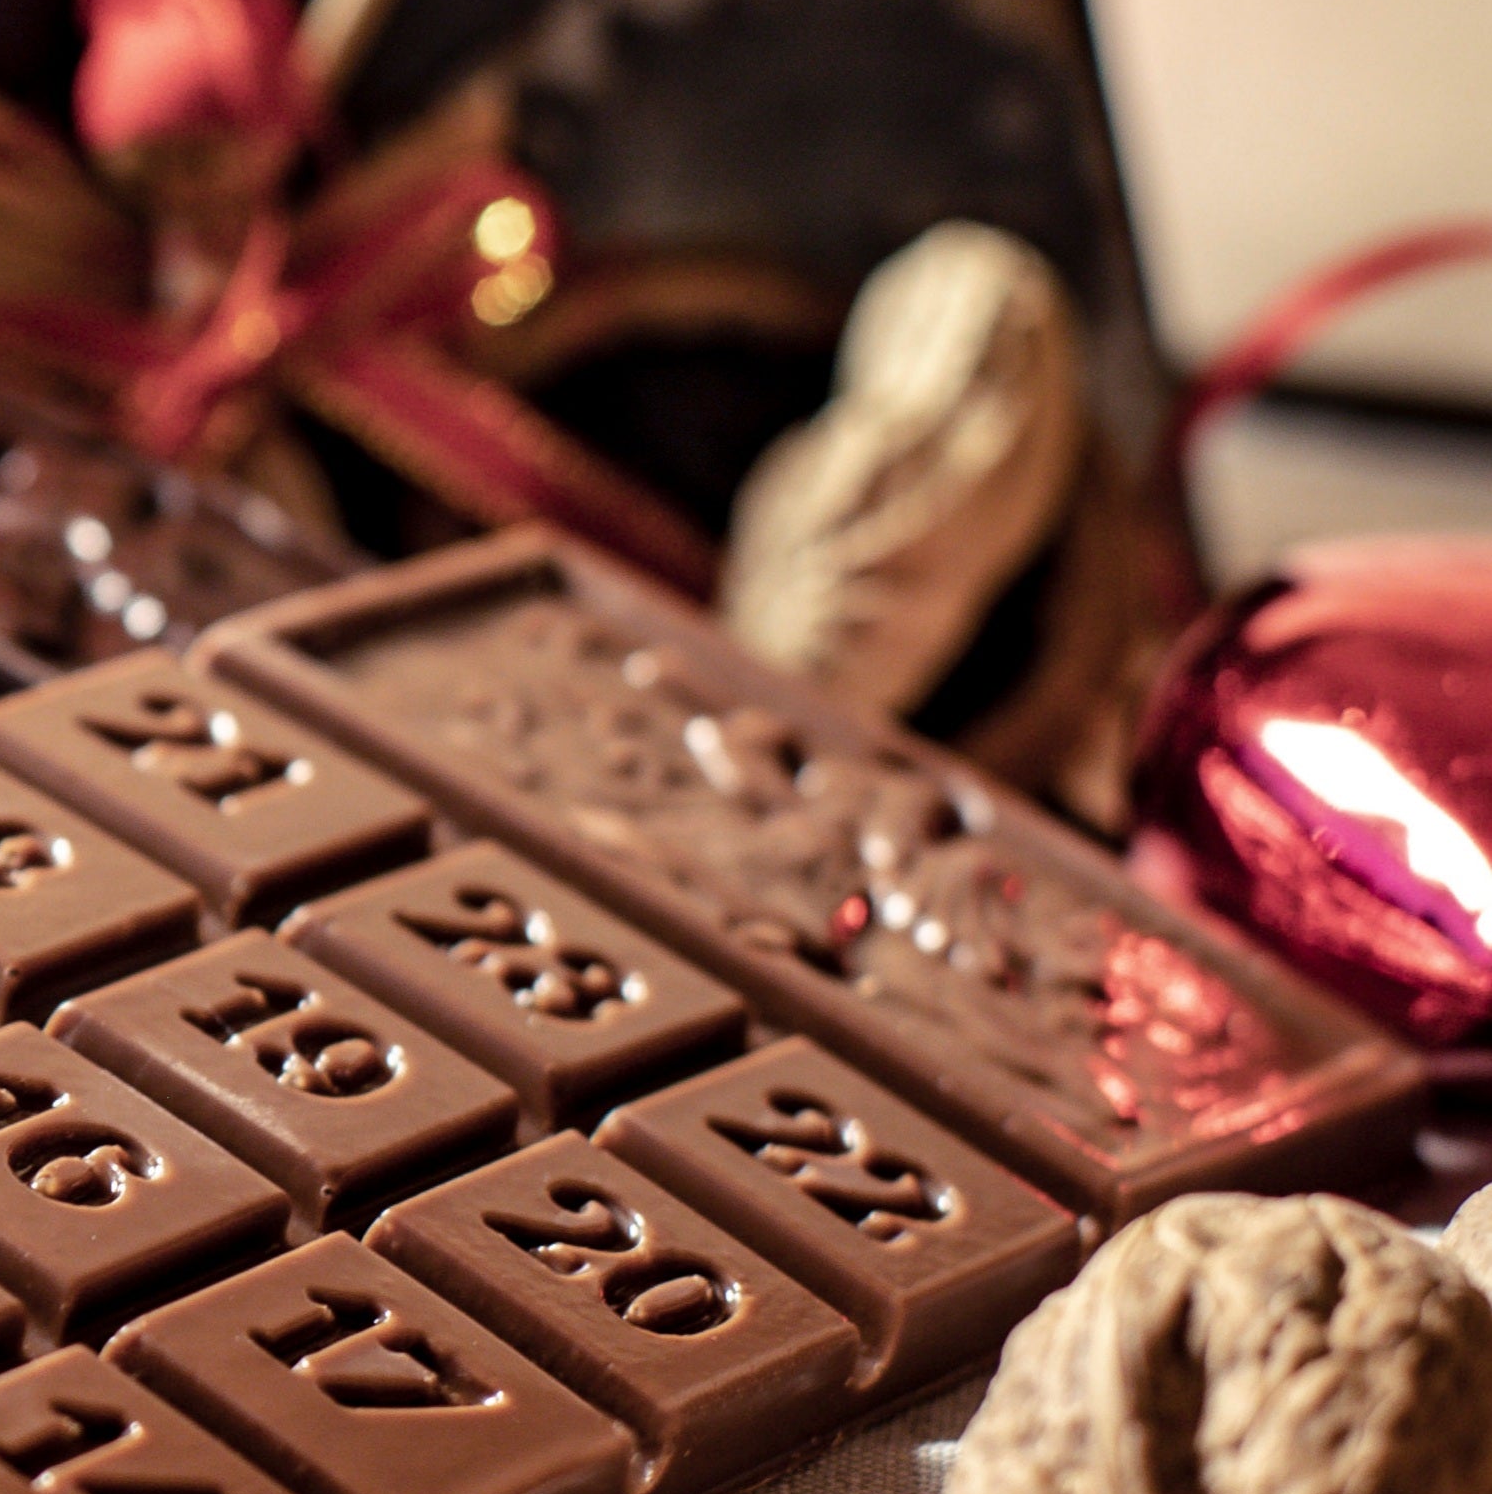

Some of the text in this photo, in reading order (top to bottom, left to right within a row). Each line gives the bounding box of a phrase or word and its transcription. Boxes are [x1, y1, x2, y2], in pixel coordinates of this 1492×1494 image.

[78, 692, 313, 815] 21
[394, 887, 649, 1029] 23
[181, 971, 408, 1100] 19
[706, 1087, 963, 1243] 22
[483, 1178, 746, 1338] 20
[249, 1286, 505, 1412] 17
